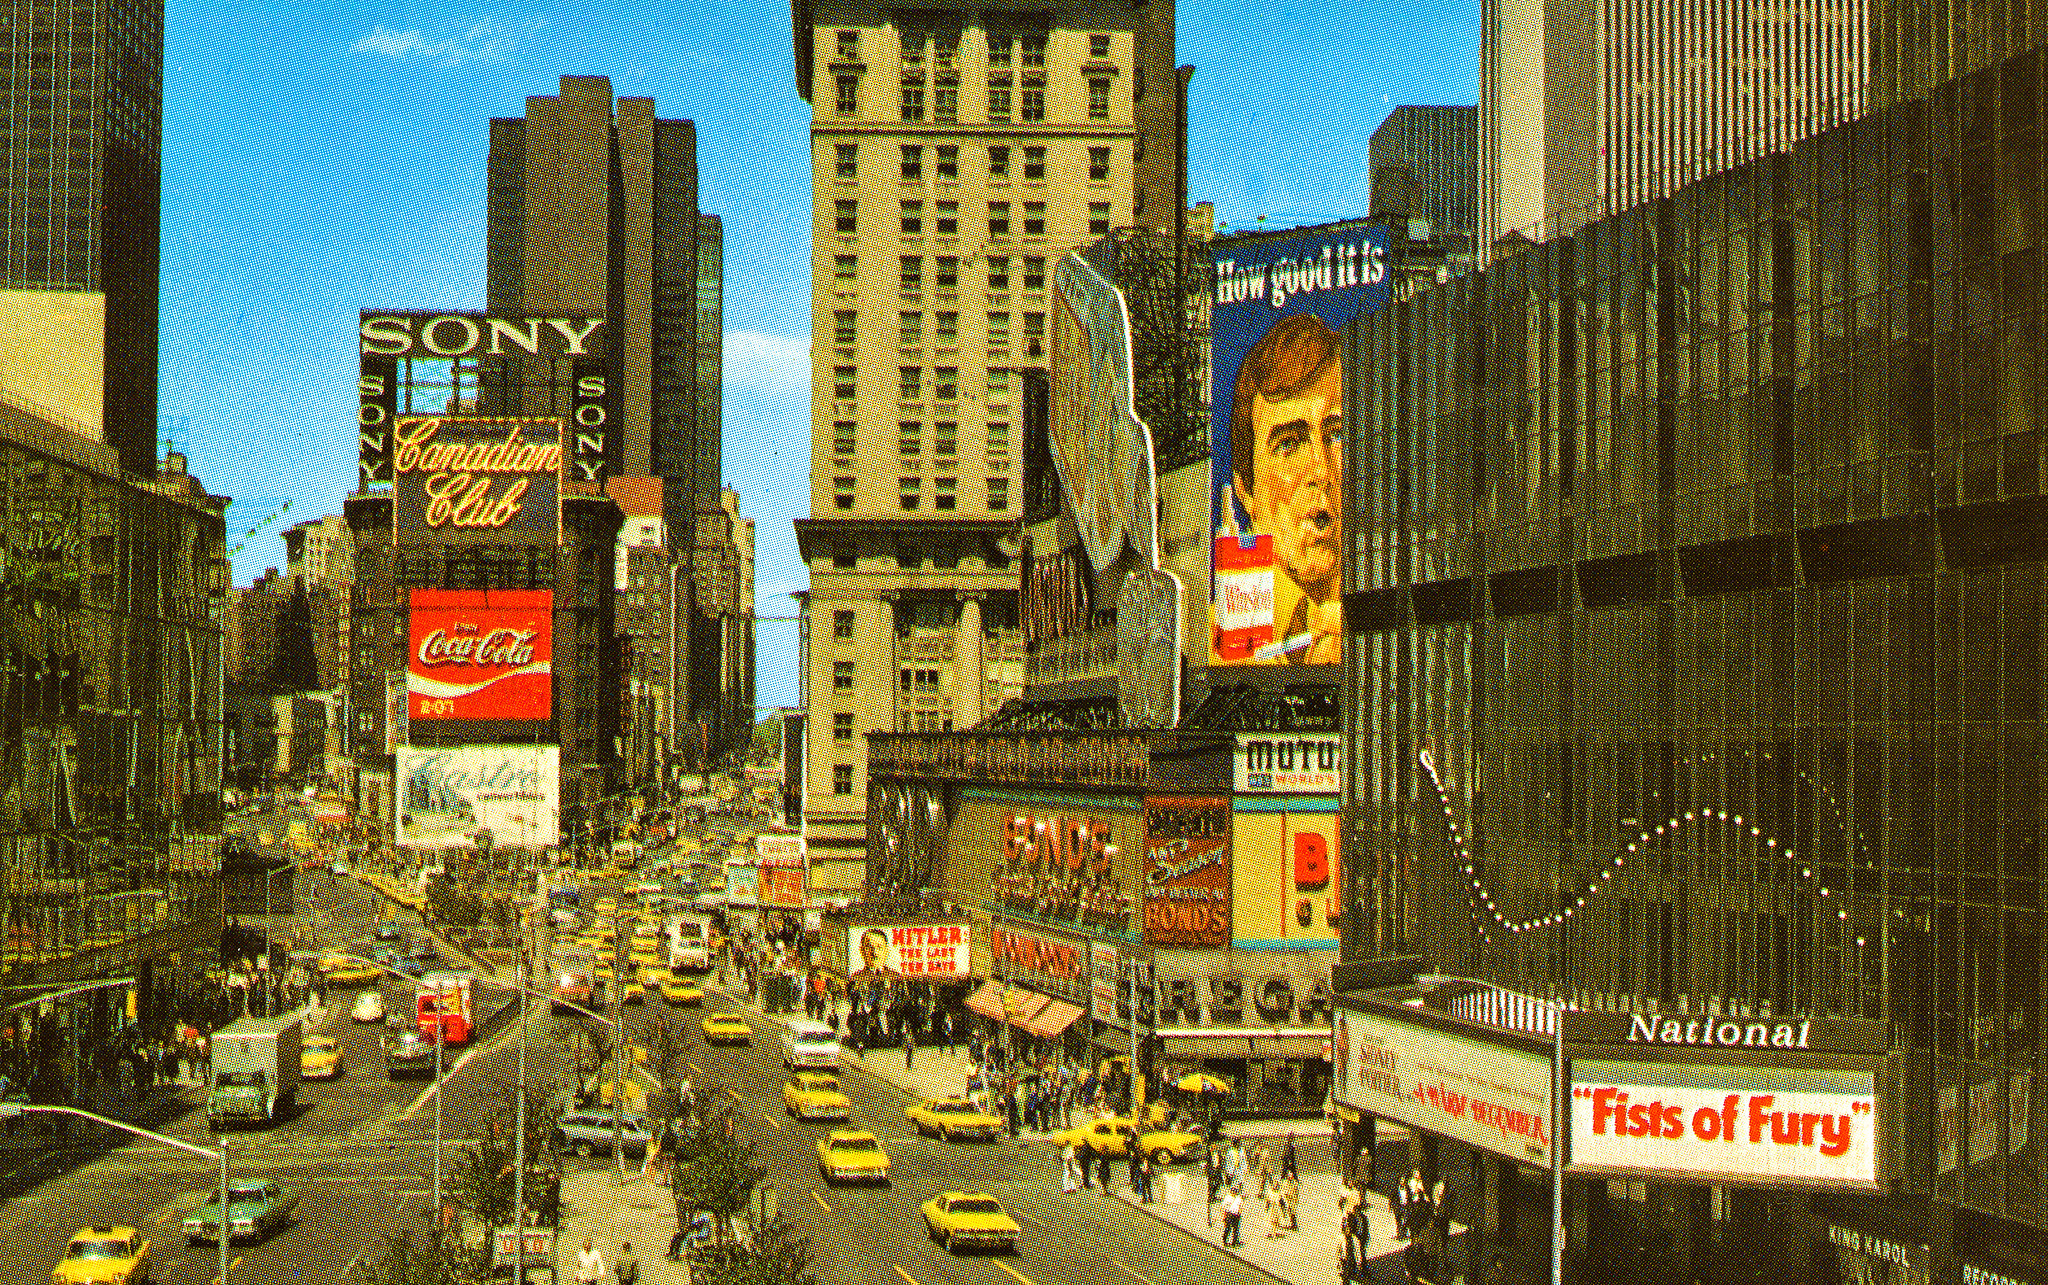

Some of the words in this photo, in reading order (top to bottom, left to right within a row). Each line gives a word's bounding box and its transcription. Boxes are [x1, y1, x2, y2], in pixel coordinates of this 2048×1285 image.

[1216, 259, 1267, 303] How
[1271, 246, 1332, 308] good
[1337, 243, 1357, 288] it
[1361, 239, 1385, 284] is
[360, 316, 606, 355] SONY
[359, 374, 386, 481] SONY
[395, 418, 562, 473] Canadian
[575, 375, 607, 482] SONY
[426, 473, 530, 527] Club
[418, 628, 538, 667] Coca-Cola
[1246, 740, 1340, 771] MUTU
[927, 946, 956, 959] LAST
[1627, 1014, 1811, 1049] National
[1691, 1094, 1740, 1142] of
[1828, 1223, 1860, 1252] KING
[1864, 1233, 1911, 1268] KAROL
